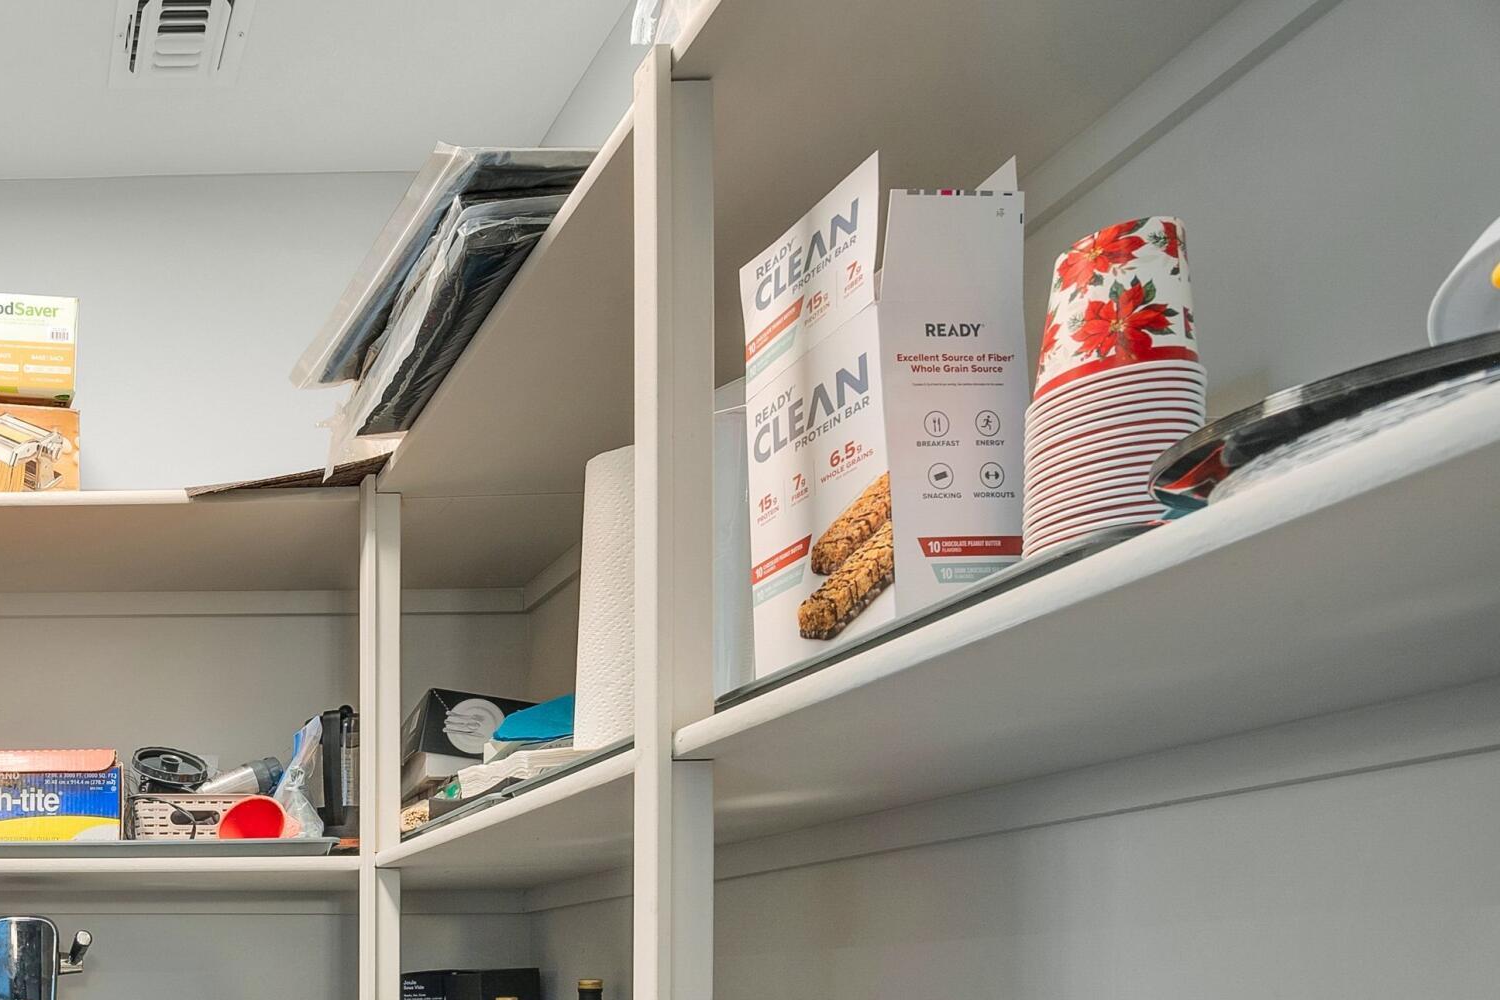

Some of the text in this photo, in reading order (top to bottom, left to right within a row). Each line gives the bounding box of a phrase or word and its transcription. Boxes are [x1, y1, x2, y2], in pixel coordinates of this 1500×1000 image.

[756, 197, 859, 311] CLEAN
[756, 239, 795, 280] READY
[792, 235, 857, 294] PROTEIN BAR
[845, 274, 864, 293] FIBER
[804, 303, 830, 326] PROTEIN
[925, 323, 981, 337] READY
[897, 353, 939, 362] Excellent
[942, 353, 974, 362] Source
[976, 353, 986, 362] of
[911, 364, 1003, 373] Whole Grain Source
[753, 352, 869, 463] CLEAN
[755, 385, 793, 427] READY
[795, 395, 870, 452] PROTEIN BAR
[820, 449, 874, 484] WHOLE GRAINS
[791, 487, 809, 501] FIBER
[757, 505, 780, 524] PROTEIN
[928, 541, 941, 553] 10
[940, 567, 953, 579] 10
